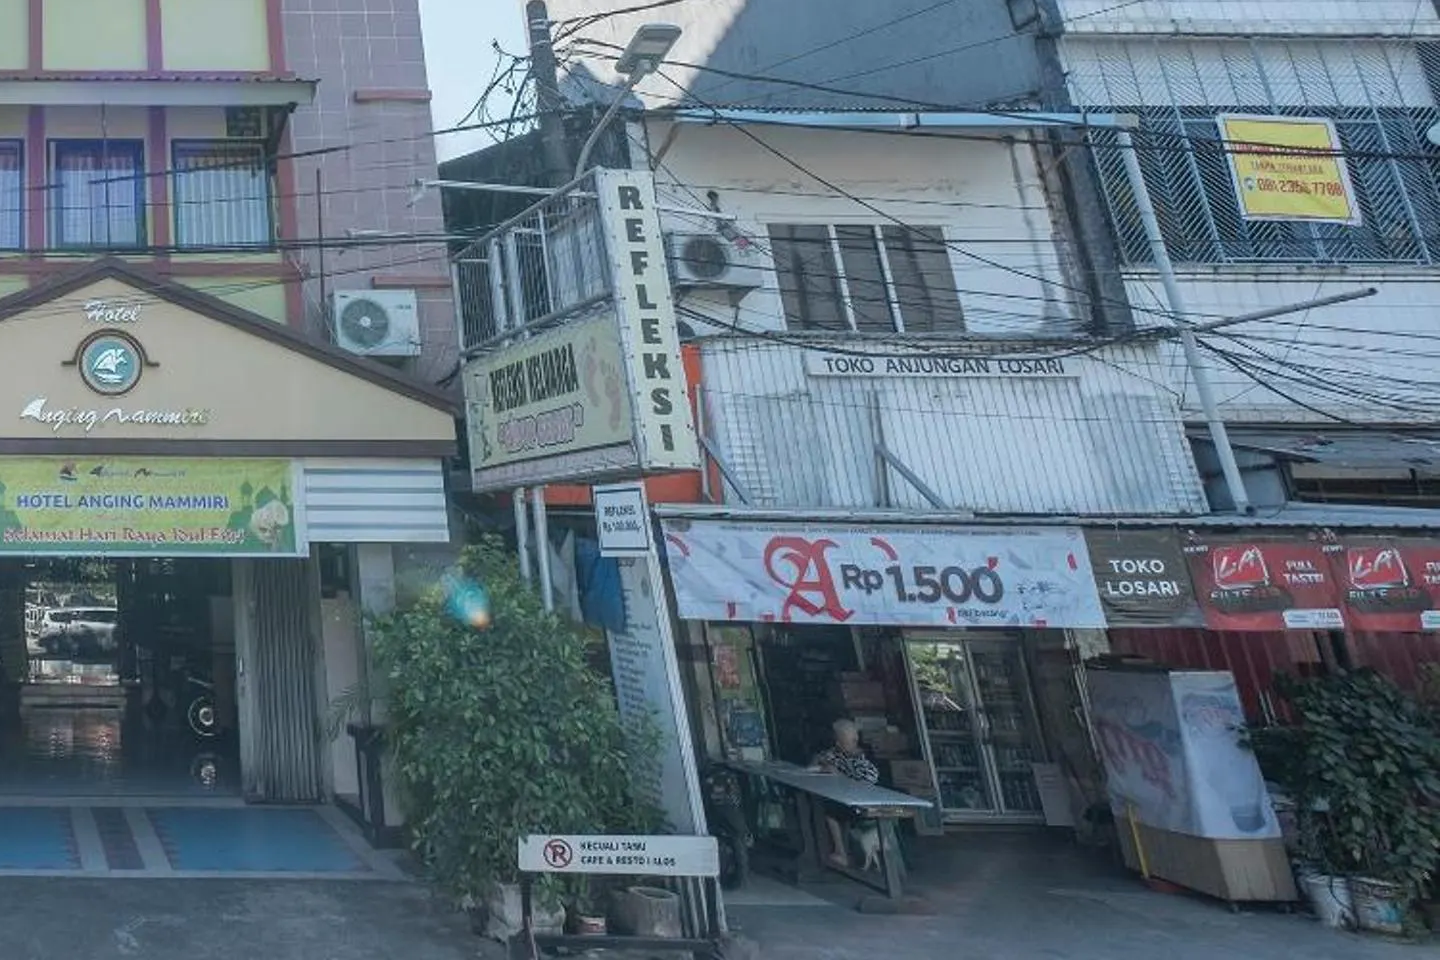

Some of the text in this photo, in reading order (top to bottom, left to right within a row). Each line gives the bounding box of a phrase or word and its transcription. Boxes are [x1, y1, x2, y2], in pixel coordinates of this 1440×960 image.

[83, 299, 142, 323] Hotel
[618, 185, 674, 452] REFLEKSI
[823, 357, 1065, 374] TOKO ANJUNGAN LOSARI
[20, 394, 98, 431] Anging
[16, 494, 229, 510] HOTEL ANGING MAMMIRI
[80, 526, 117, 541] Hari
[123, 527, 167, 544] Raya
[1109, 559, 1165, 574] TOKO
[1106, 580, 1180, 597] LOSARI
